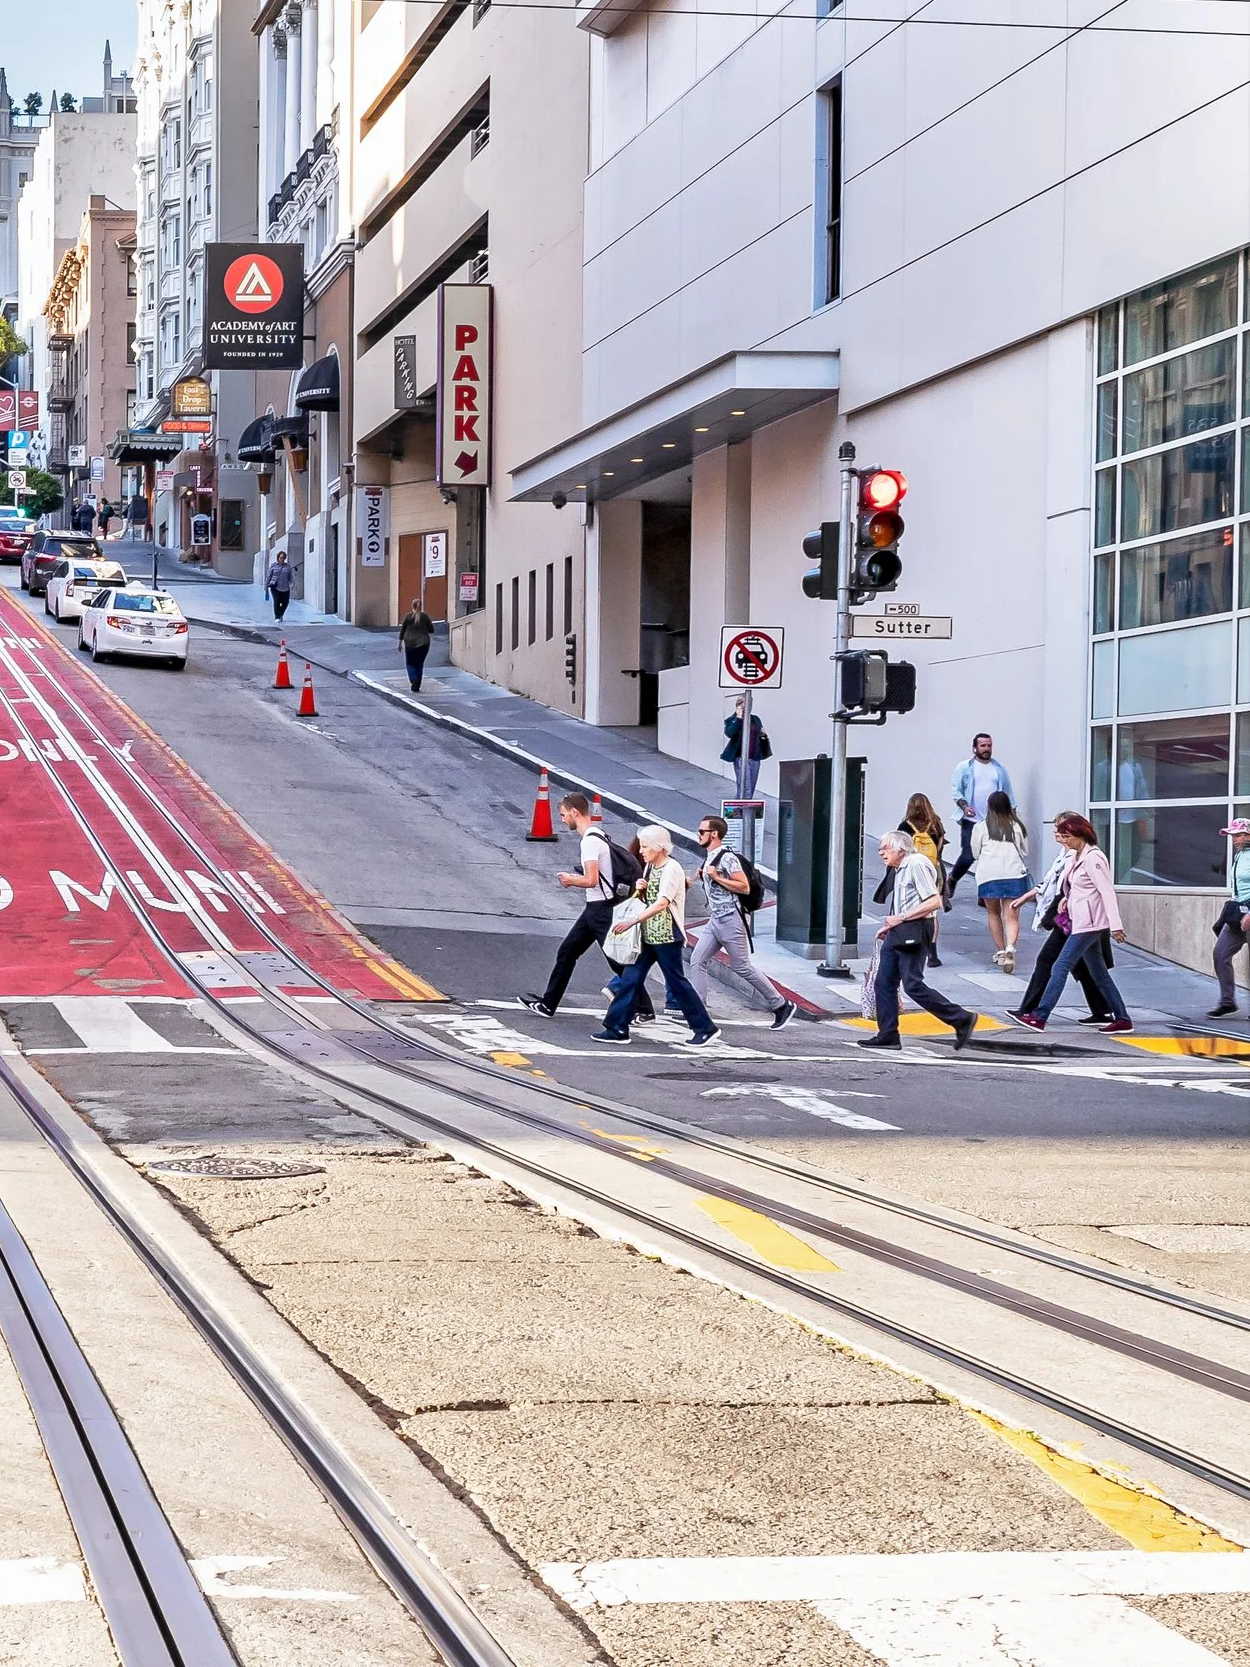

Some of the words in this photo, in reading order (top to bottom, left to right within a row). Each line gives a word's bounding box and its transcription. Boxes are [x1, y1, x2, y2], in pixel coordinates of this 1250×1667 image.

[210, 321, 265, 331] ACADEMY
[265, 321, 276, 333] of
[275, 321, 297, 331] ART
[210, 334, 297, 344] UNIVERSITY
[395, 347, 414, 399] PARKING
[452, 324, 481, 441] PARK
[183, 385, 199, 394] Last
[182, 395, 203, 405] Drop
[179, 404, 206, 413] Tavern
[368, 497, 380, 539] PARK
[897, 605, 917, 614] 500
[875, 620, 931, 634] Sutter
[49, 870, 288, 915] MUNI
